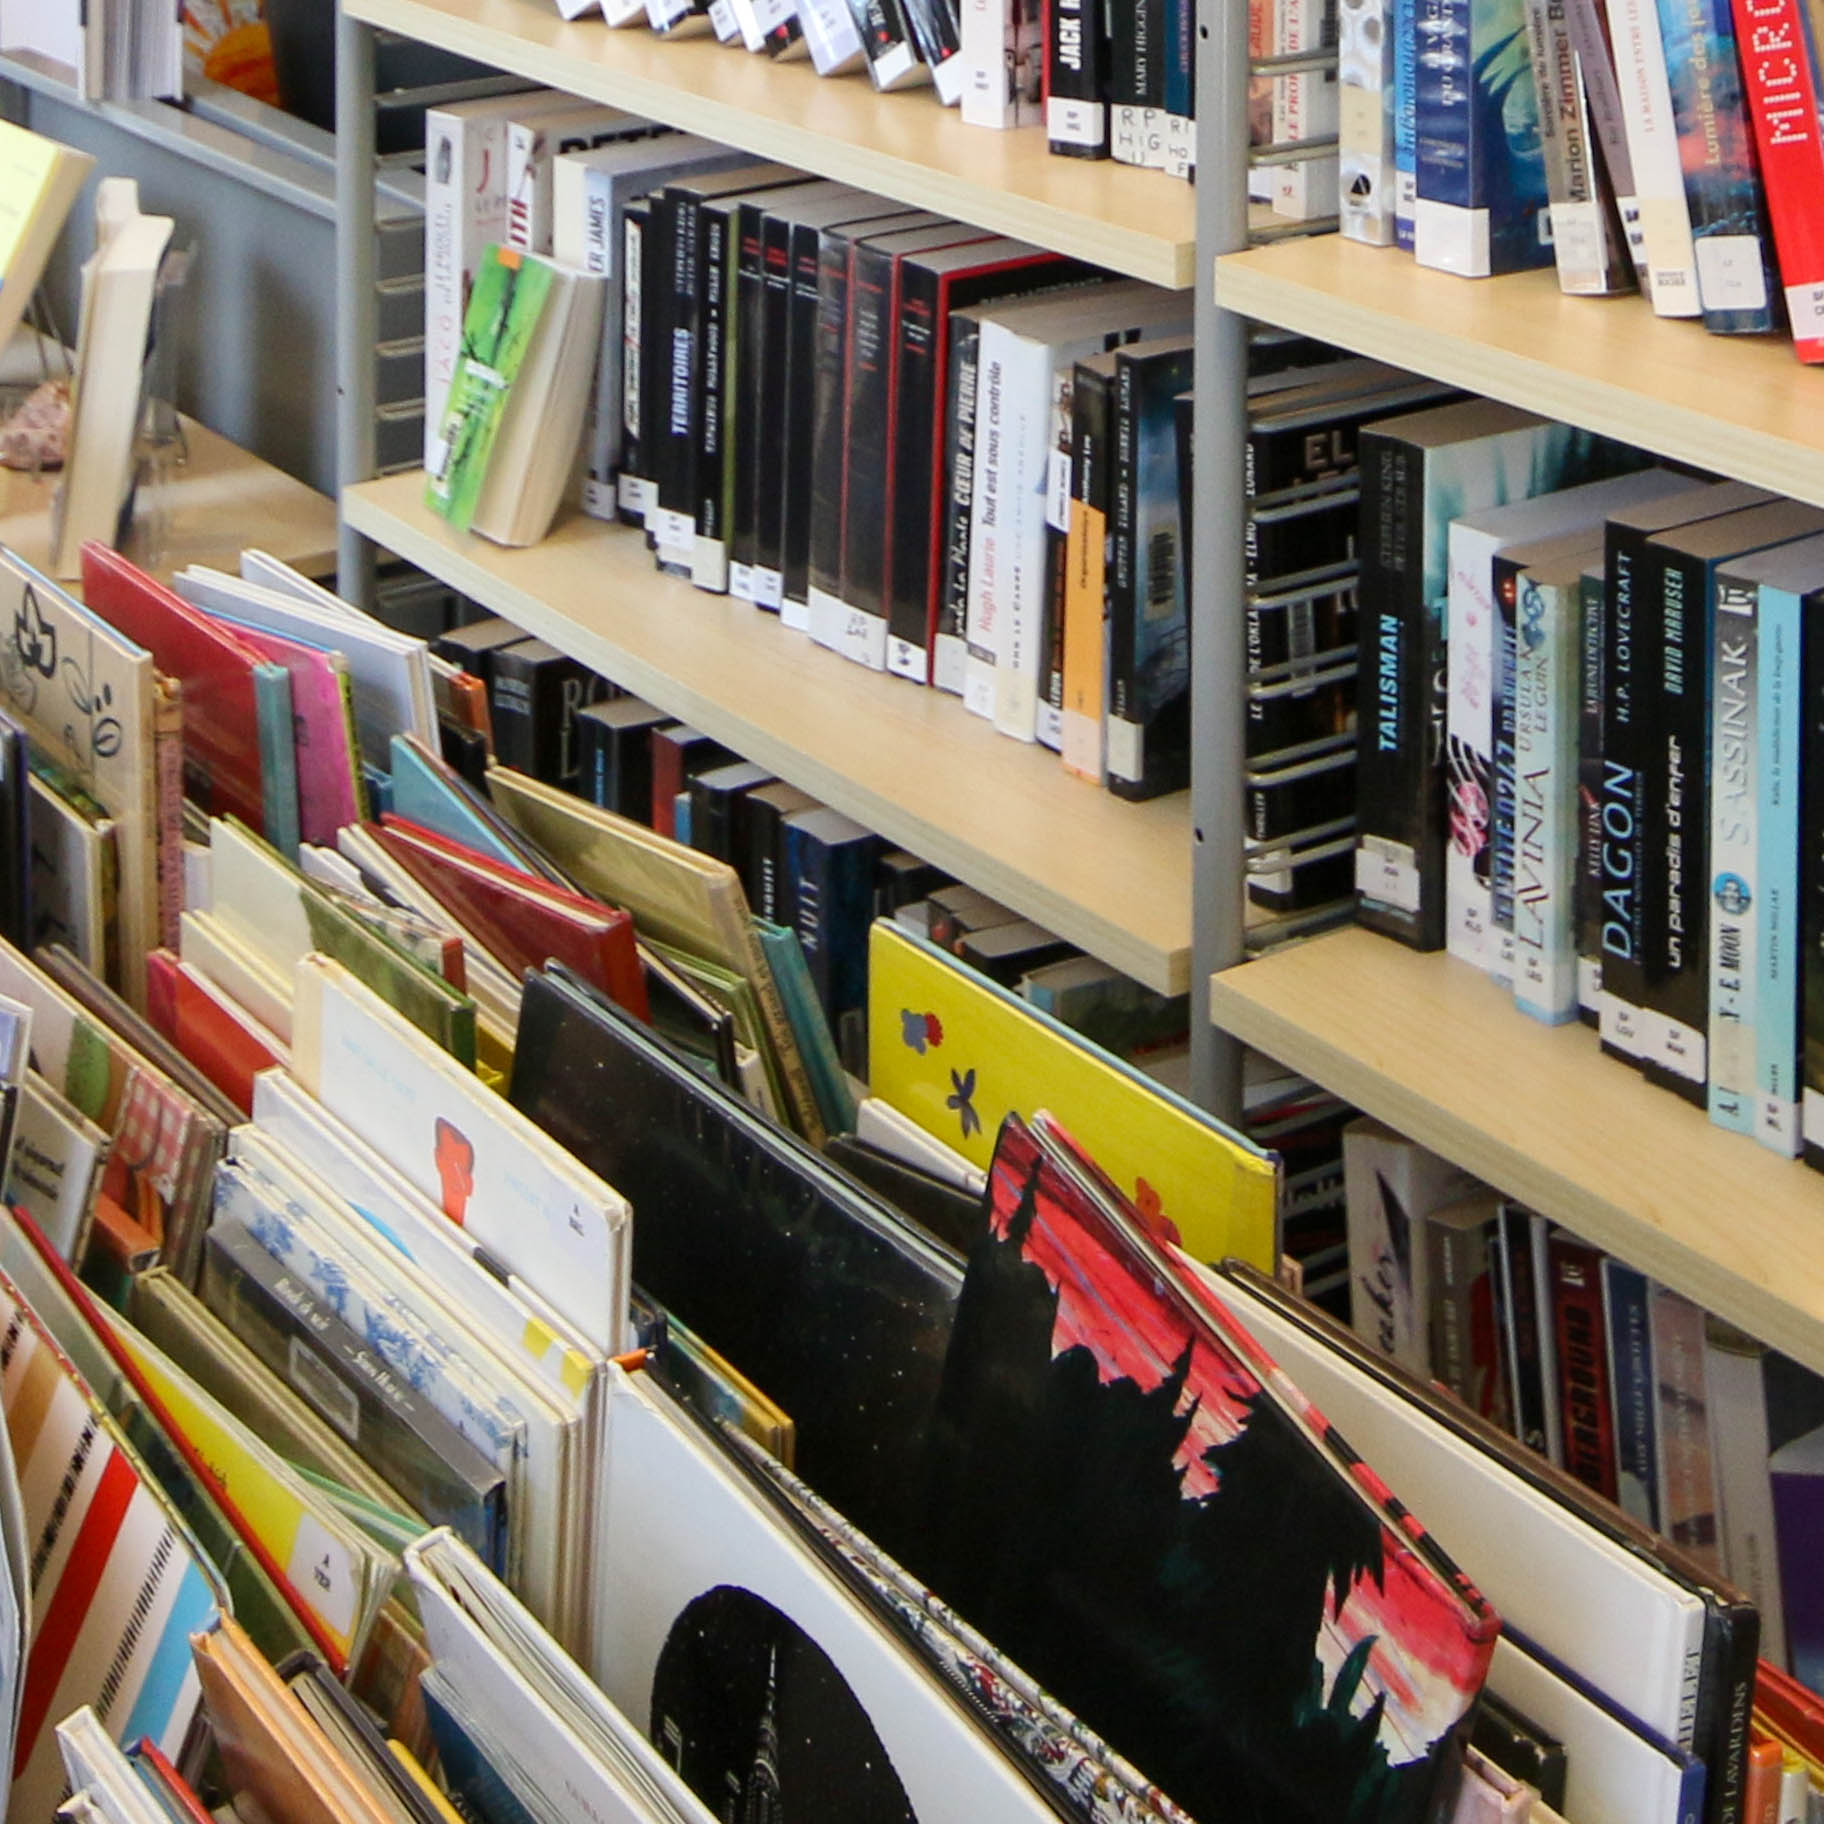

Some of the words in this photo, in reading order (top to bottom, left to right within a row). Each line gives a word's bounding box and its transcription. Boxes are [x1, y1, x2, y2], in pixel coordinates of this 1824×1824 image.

[1060, 13, 1082, 69] JACK
[1559, 73, 1583, 143] Zimmer
[1702, 83, 1723, 169] Lumière
[589, 197, 605, 251] JAMES
[673, 327, 694, 436] TERRITOIRES
[954, 358, 977, 421] PIERRE
[984, 360, 1004, 425] contrôle
[983, 428, 1003, 466] sous
[952, 454, 975, 506] CŒUR
[982, 495, 996, 527] Tout
[980, 537, 996, 586] Laurie
[979, 591, 997, 632] Hugh
[1616, 549, 1632, 673] LOVECRAFT
[1665, 568, 1683, 636] MARUSEK
[1378, 614, 1398, 753] TALISMAN
[1664, 640, 1681, 693] DAVID
[1520, 674, 1536, 751] URSULA
[1615, 681, 1631, 723] H.P.
[1721, 640, 1749, 847] SASSINAK
[1666, 733, 1683, 834] d'enfer
[1517, 766, 1549, 953] LAVINIA
[1601, 760, 1635, 959] DAGON
[1667, 840, 1683, 930] paradis
[1668, 936, 1681, 967] un
[1721, 923, 1742, 975] MOON
